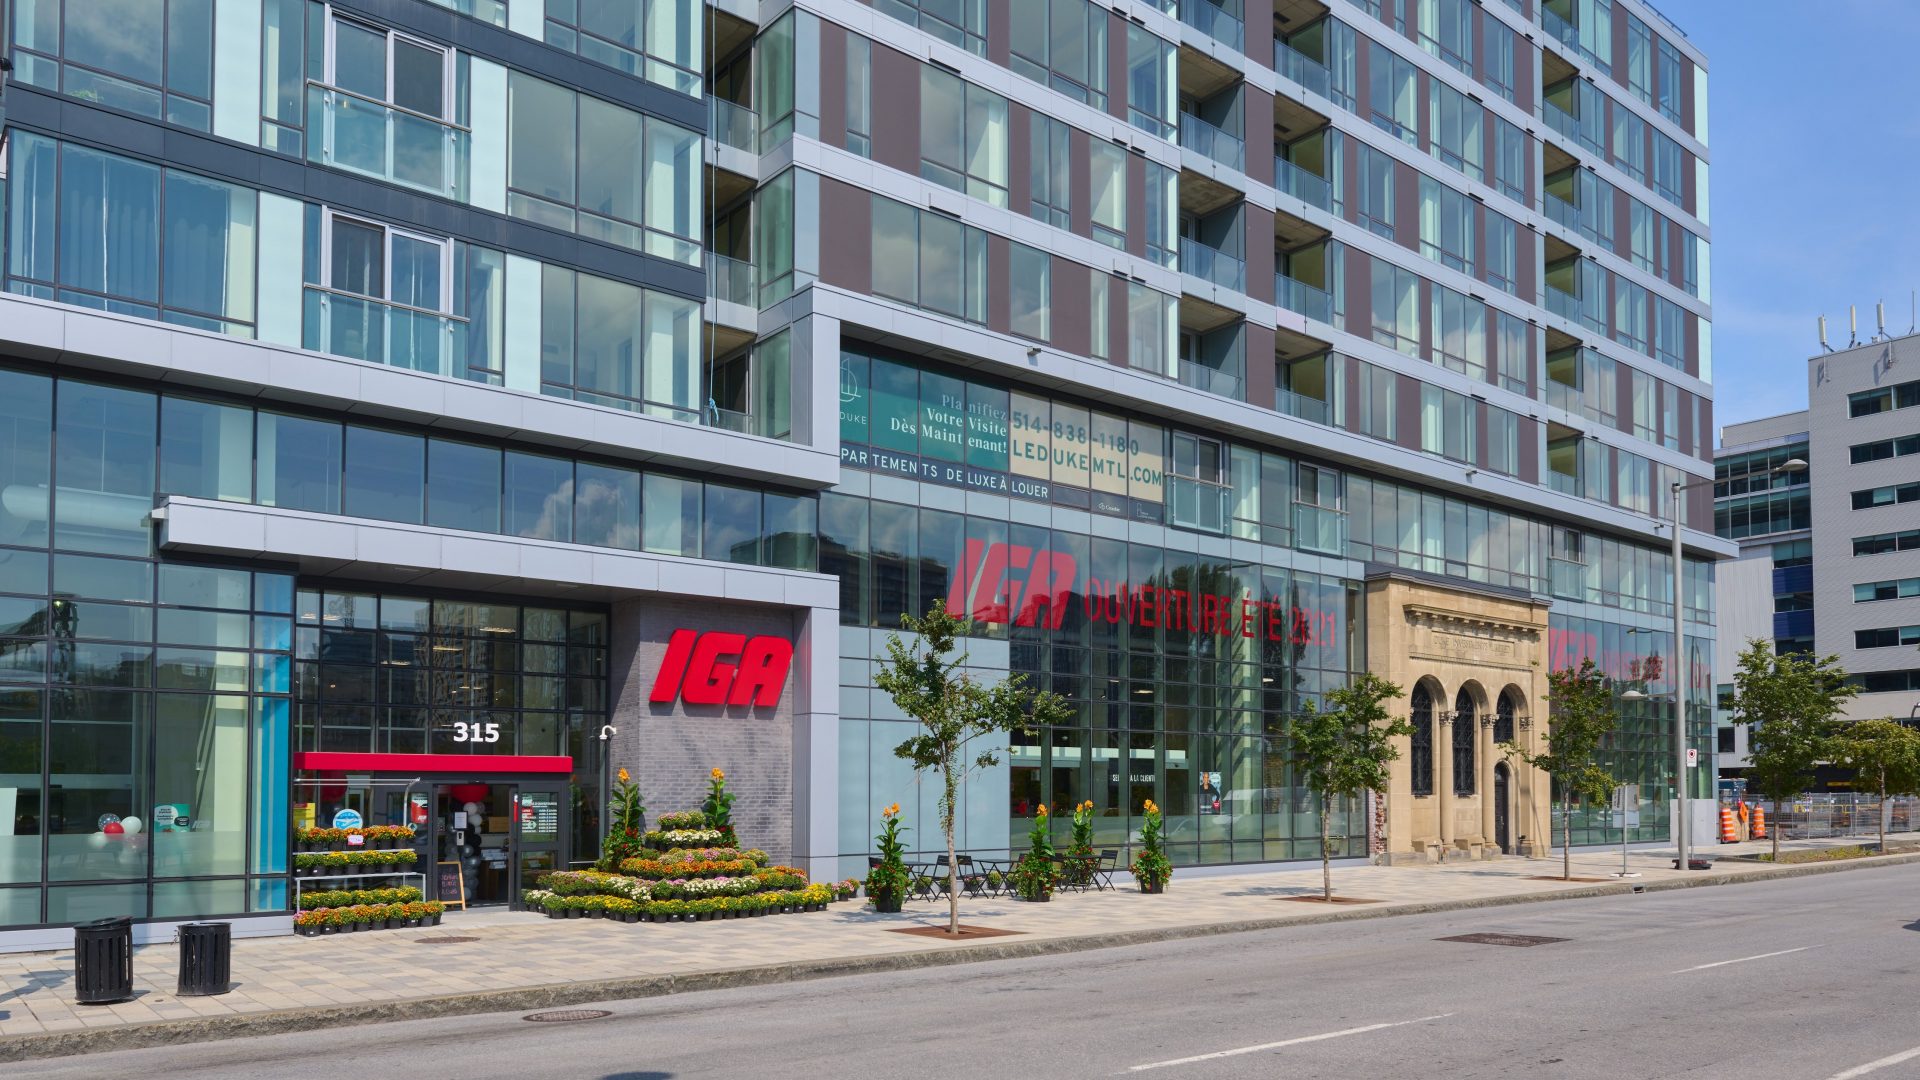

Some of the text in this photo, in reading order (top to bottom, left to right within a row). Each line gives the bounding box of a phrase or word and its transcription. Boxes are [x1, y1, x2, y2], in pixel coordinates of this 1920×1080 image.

[840, 411, 867, 425] DUKE
[927, 407, 1007, 437] Votre Visite
[942, 394, 1007, 420] Planifiez
[891, 417, 1007, 454] Dès Maintenant!
[1013, 411, 1139, 456] 514-838-1180
[841, 448, 1048, 498] PARTEMENTS DE LUXE À LOUER
[1013, 439, 1162, 486] LEDUKEMTL.COM
[944, 537, 1076, 630] IGA
[1084, 577, 1336, 648] OUVERTURE ÉTÉ 2021
[649, 628, 794, 707] IGA
[453, 721, 499, 743] 315
